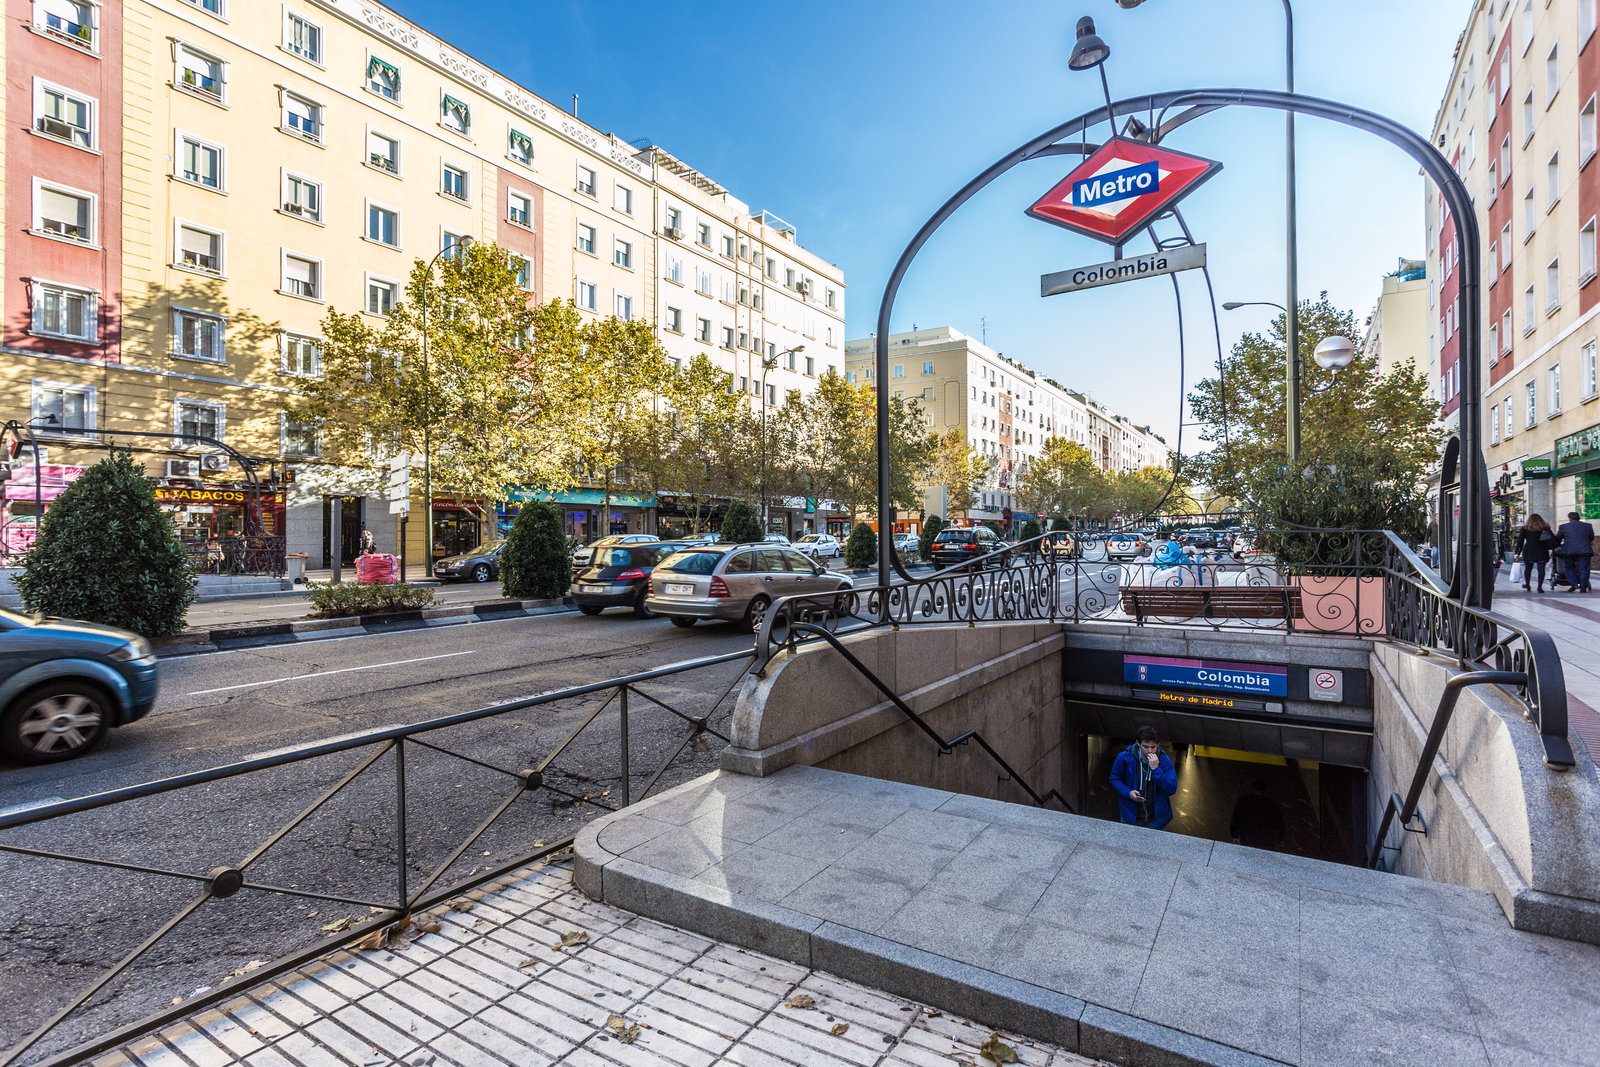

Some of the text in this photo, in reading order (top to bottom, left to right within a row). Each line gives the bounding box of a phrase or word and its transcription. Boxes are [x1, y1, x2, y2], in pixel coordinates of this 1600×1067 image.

[1080, 172, 1152, 204] Metro
[1072, 256, 1168, 286] Colombia
[171, 489, 244, 501] TABACOS
[1140, 665, 1146, 673] 8
[1140, 673, 1146, 681] 9
[1197, 670, 1270, 686] Colombia
[1160, 693, 1234, 707] Metro de Madrid
